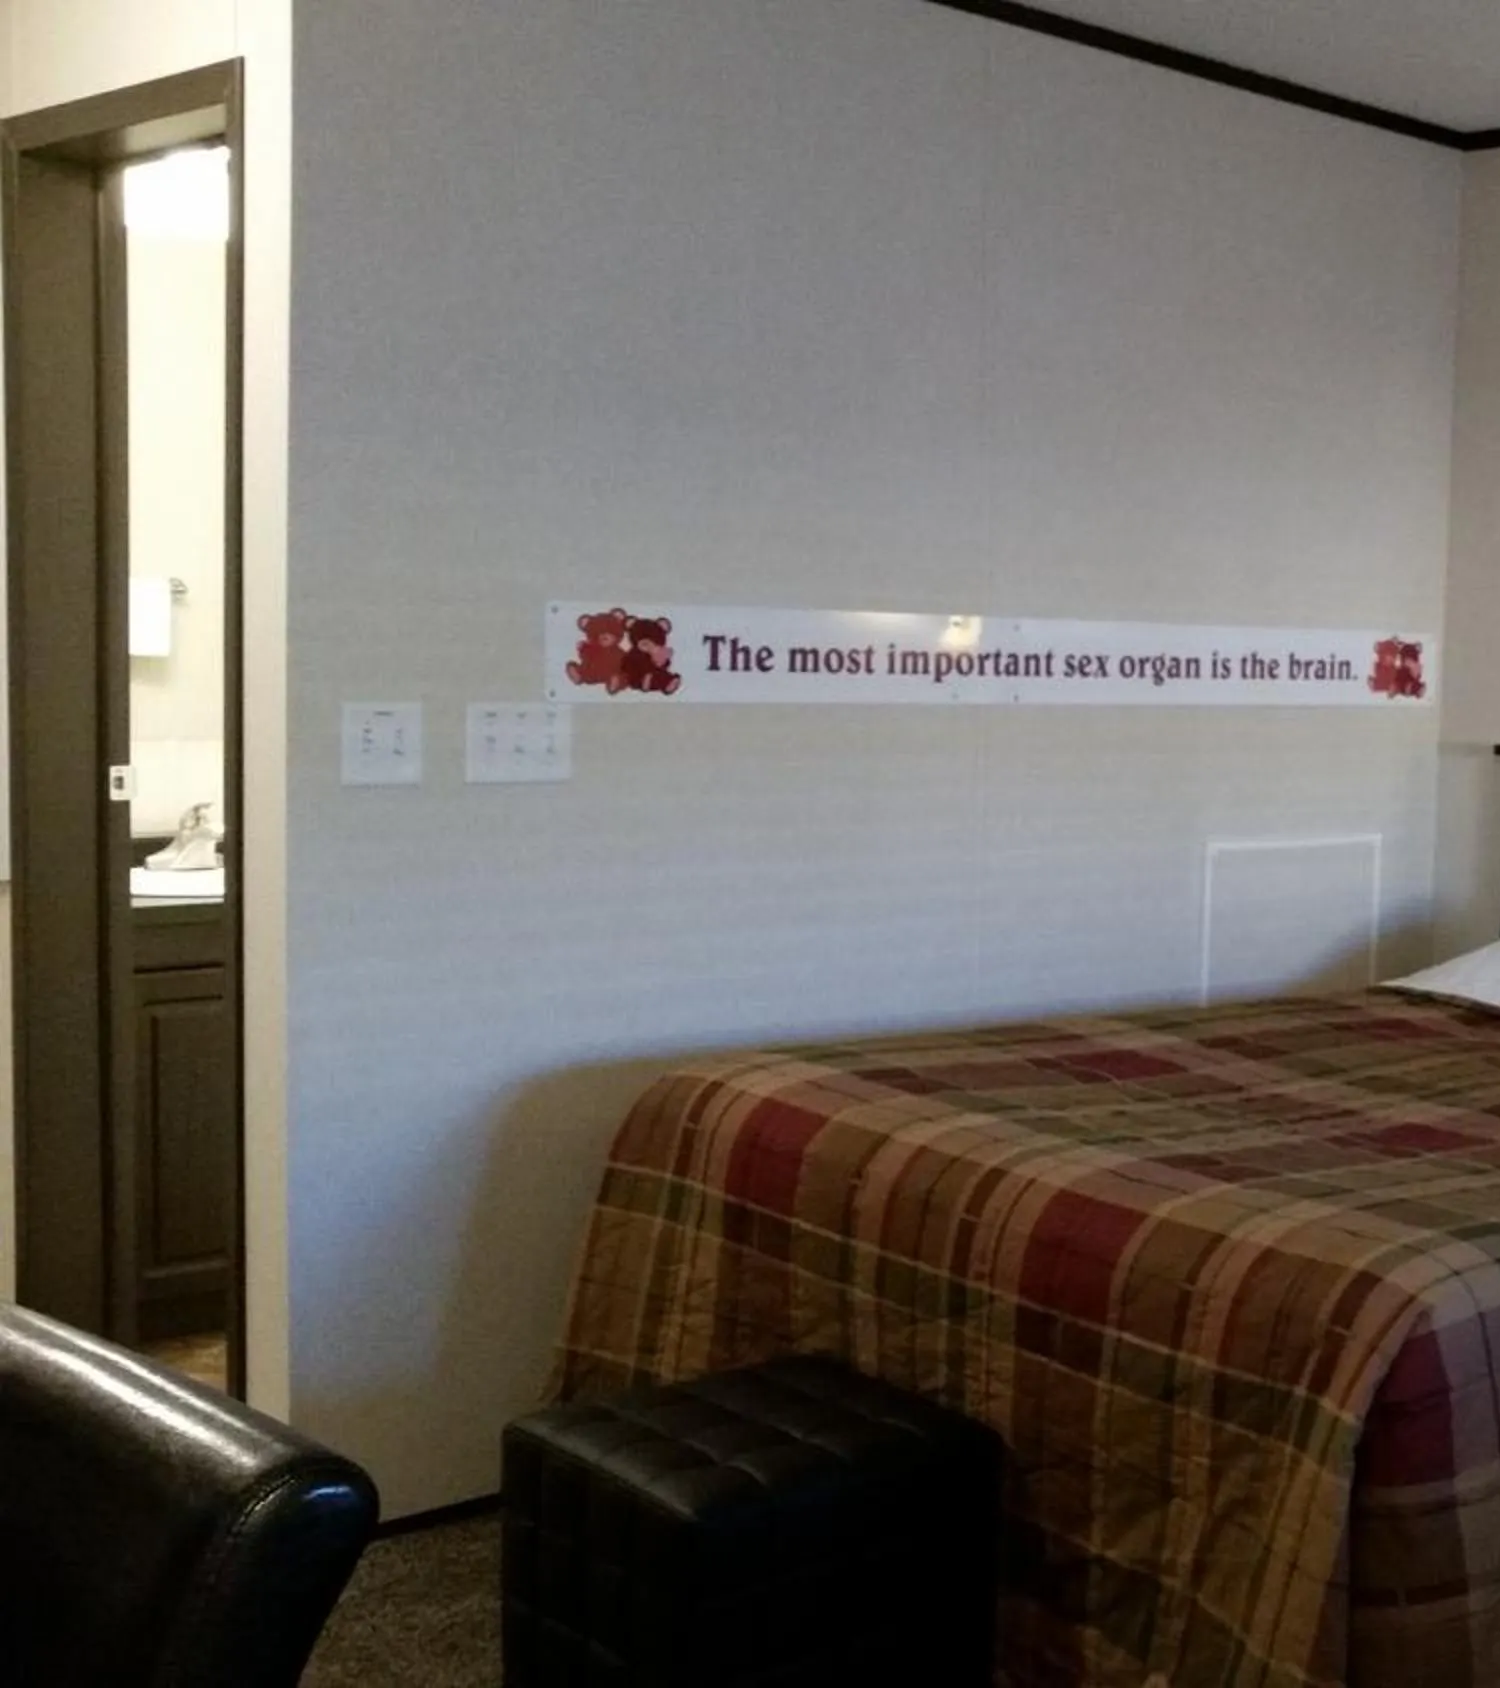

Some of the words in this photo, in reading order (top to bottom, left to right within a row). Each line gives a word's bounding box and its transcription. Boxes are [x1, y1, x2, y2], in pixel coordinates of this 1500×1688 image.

[702, 635, 776, 673] The
[786, 641, 877, 675] most
[885, 643, 1054, 682] important
[1063, 652, 1109, 679] sex
[1119, 652, 1201, 687] organ
[1210, 650, 1232, 680] is
[1239, 651, 1281, 681] the
[1287, 653, 1359, 682] brain.
